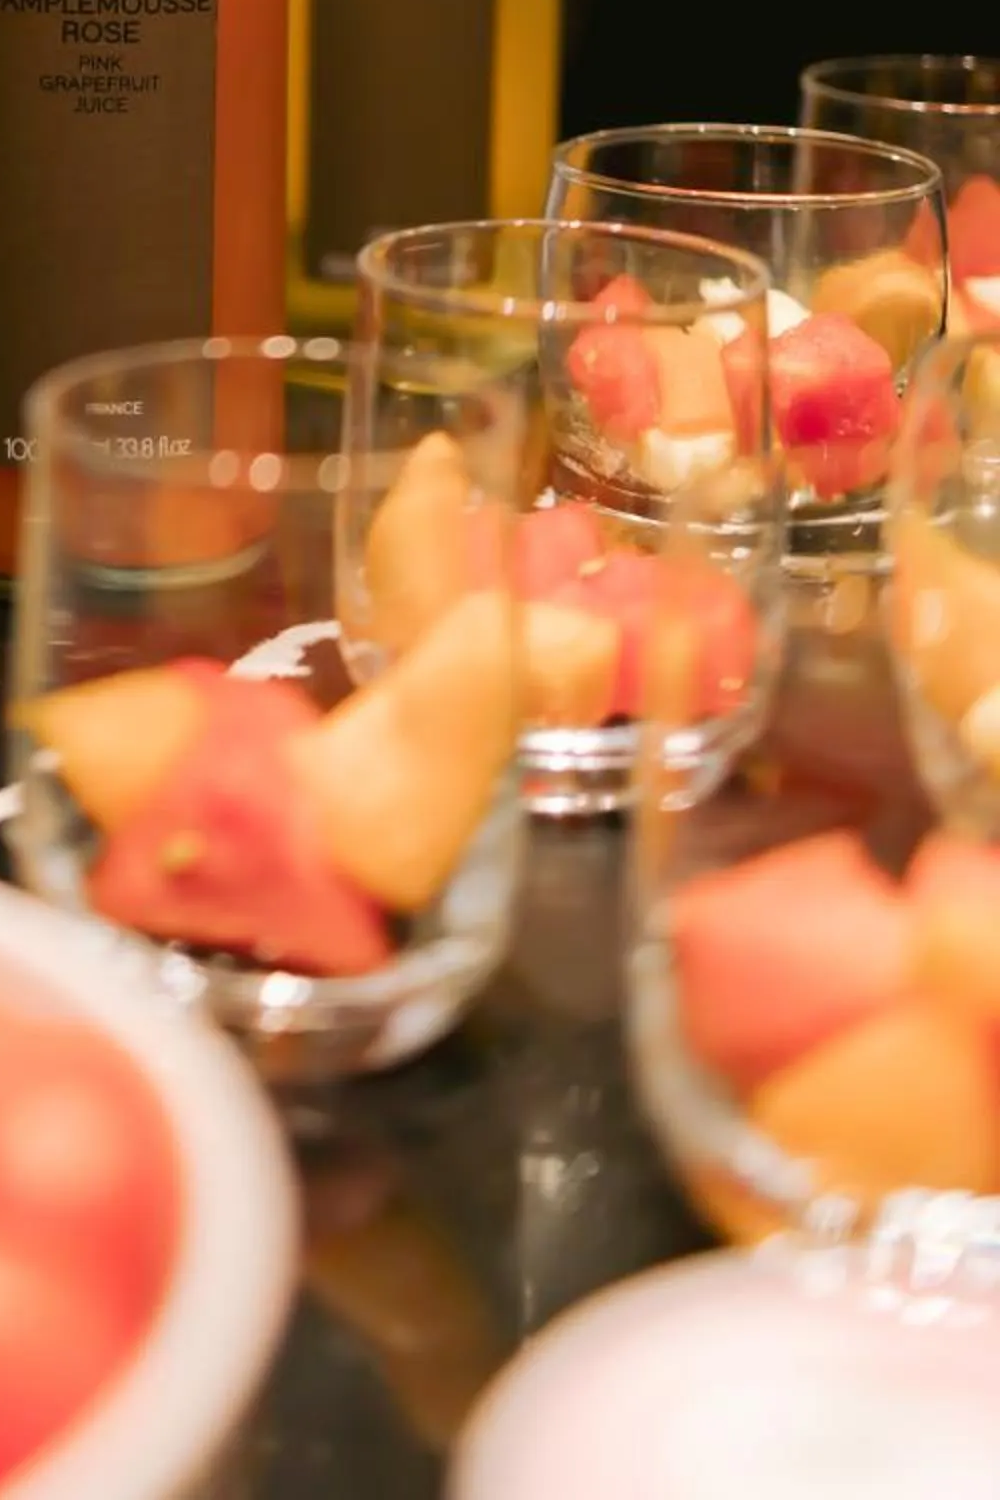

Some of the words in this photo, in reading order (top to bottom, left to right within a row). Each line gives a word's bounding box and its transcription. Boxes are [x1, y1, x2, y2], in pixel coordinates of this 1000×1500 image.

[61, 20, 141, 45] ROSE
[79, 55, 124, 72] PINK
[39, 75, 161, 92] GRAPEFRUIT
[74, 97, 129, 113] JUICE
